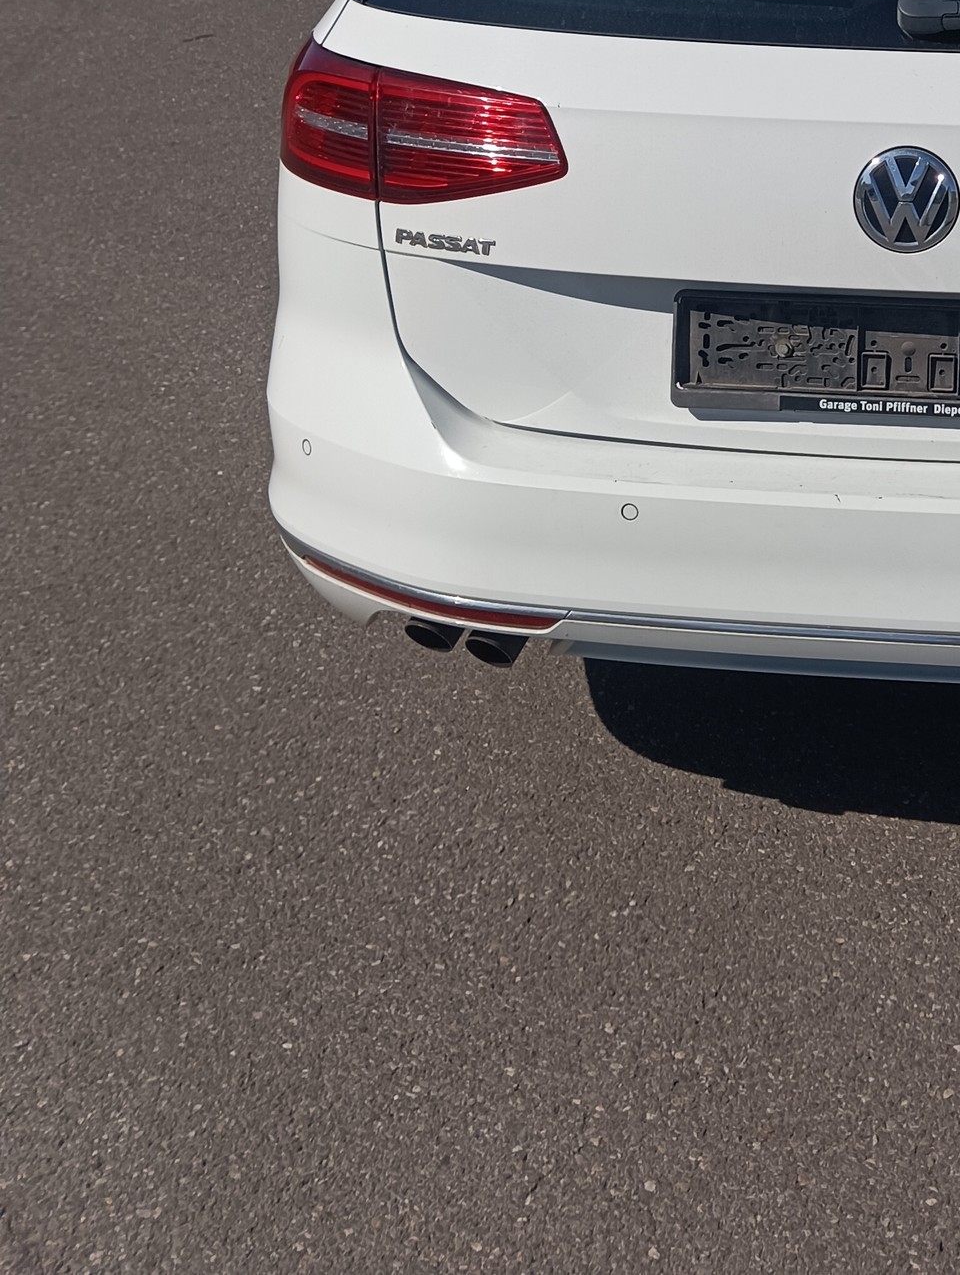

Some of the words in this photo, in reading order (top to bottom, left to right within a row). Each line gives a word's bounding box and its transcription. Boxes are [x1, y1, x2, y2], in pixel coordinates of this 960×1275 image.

[857, 147, 957, 251] VW
[395, 228, 496, 256] PASSAT
[819, 399, 858, 413] Garage
[860, 400, 883, 412] Toni
[886, 401, 928, 414] Pfiffner
